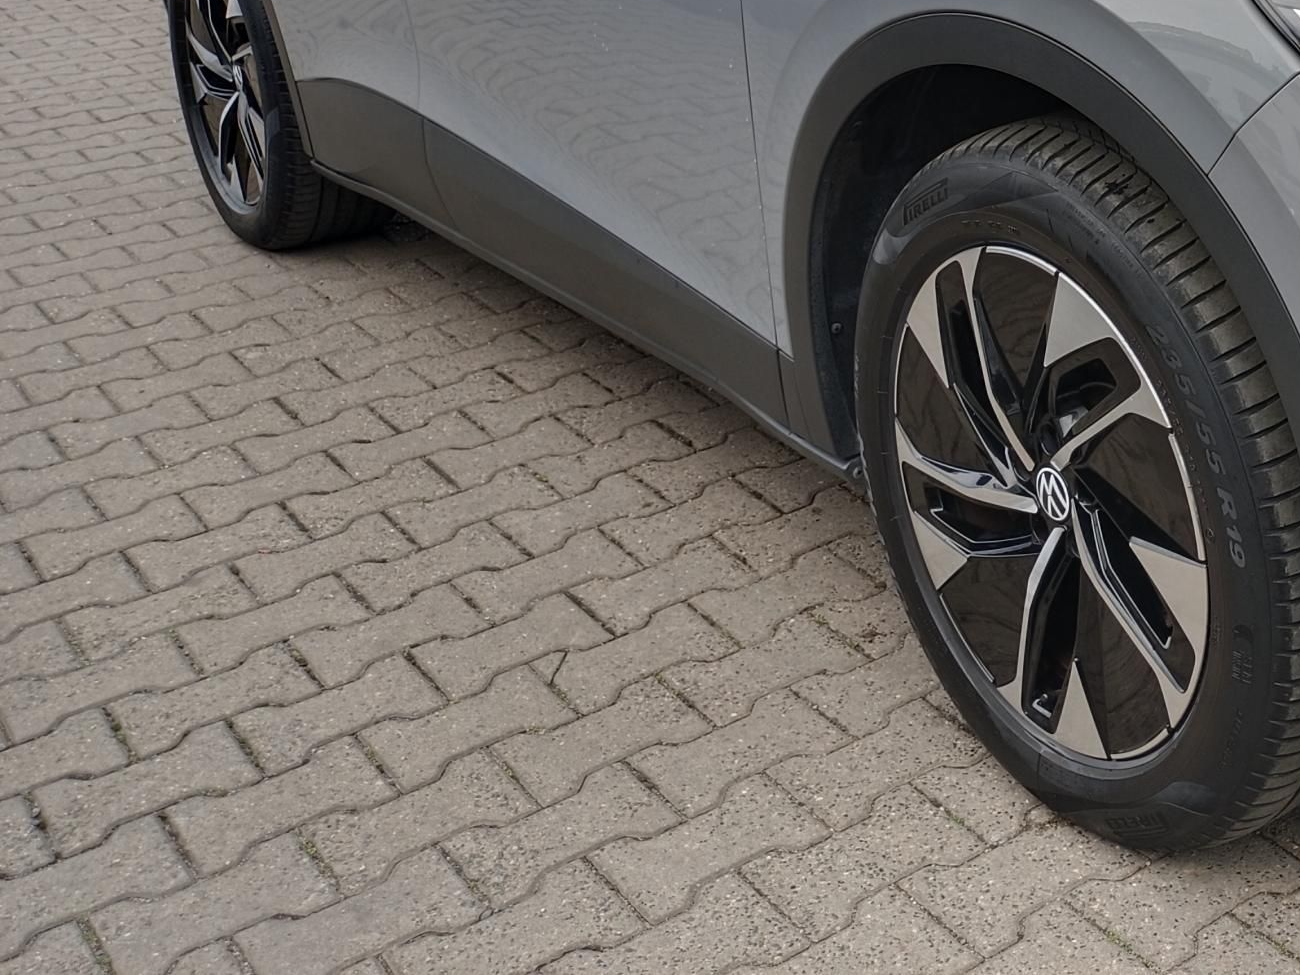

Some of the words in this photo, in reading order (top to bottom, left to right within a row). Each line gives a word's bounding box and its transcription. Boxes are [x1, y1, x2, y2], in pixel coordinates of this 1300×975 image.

[903, 177, 949, 226] PIRELLI
[1145, 324, 1228, 476] 235/55
[1216, 486, 1247, 569] R19
